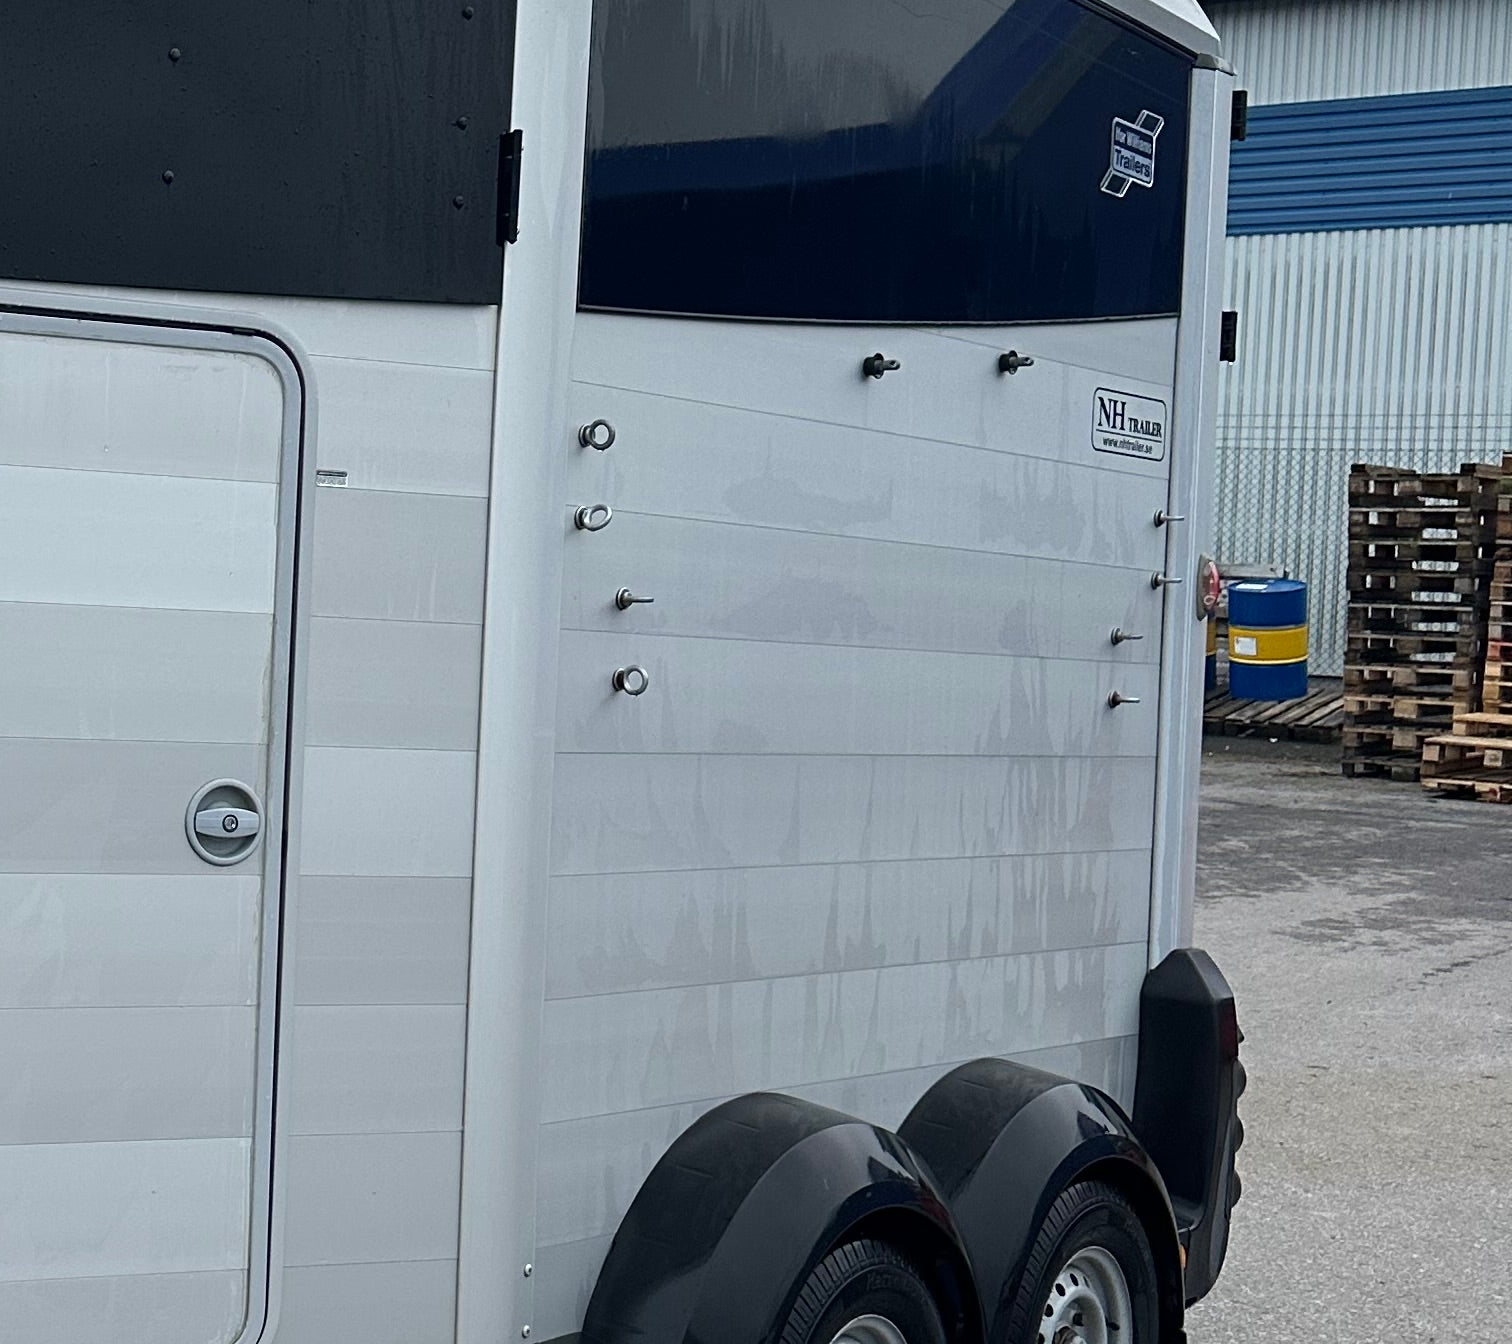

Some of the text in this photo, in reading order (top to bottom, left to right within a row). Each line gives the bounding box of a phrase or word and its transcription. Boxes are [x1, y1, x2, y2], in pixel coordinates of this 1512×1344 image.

[1114, 148, 1150, 177] Trailers
[1097, 396, 1162, 438] NH TRAILER
